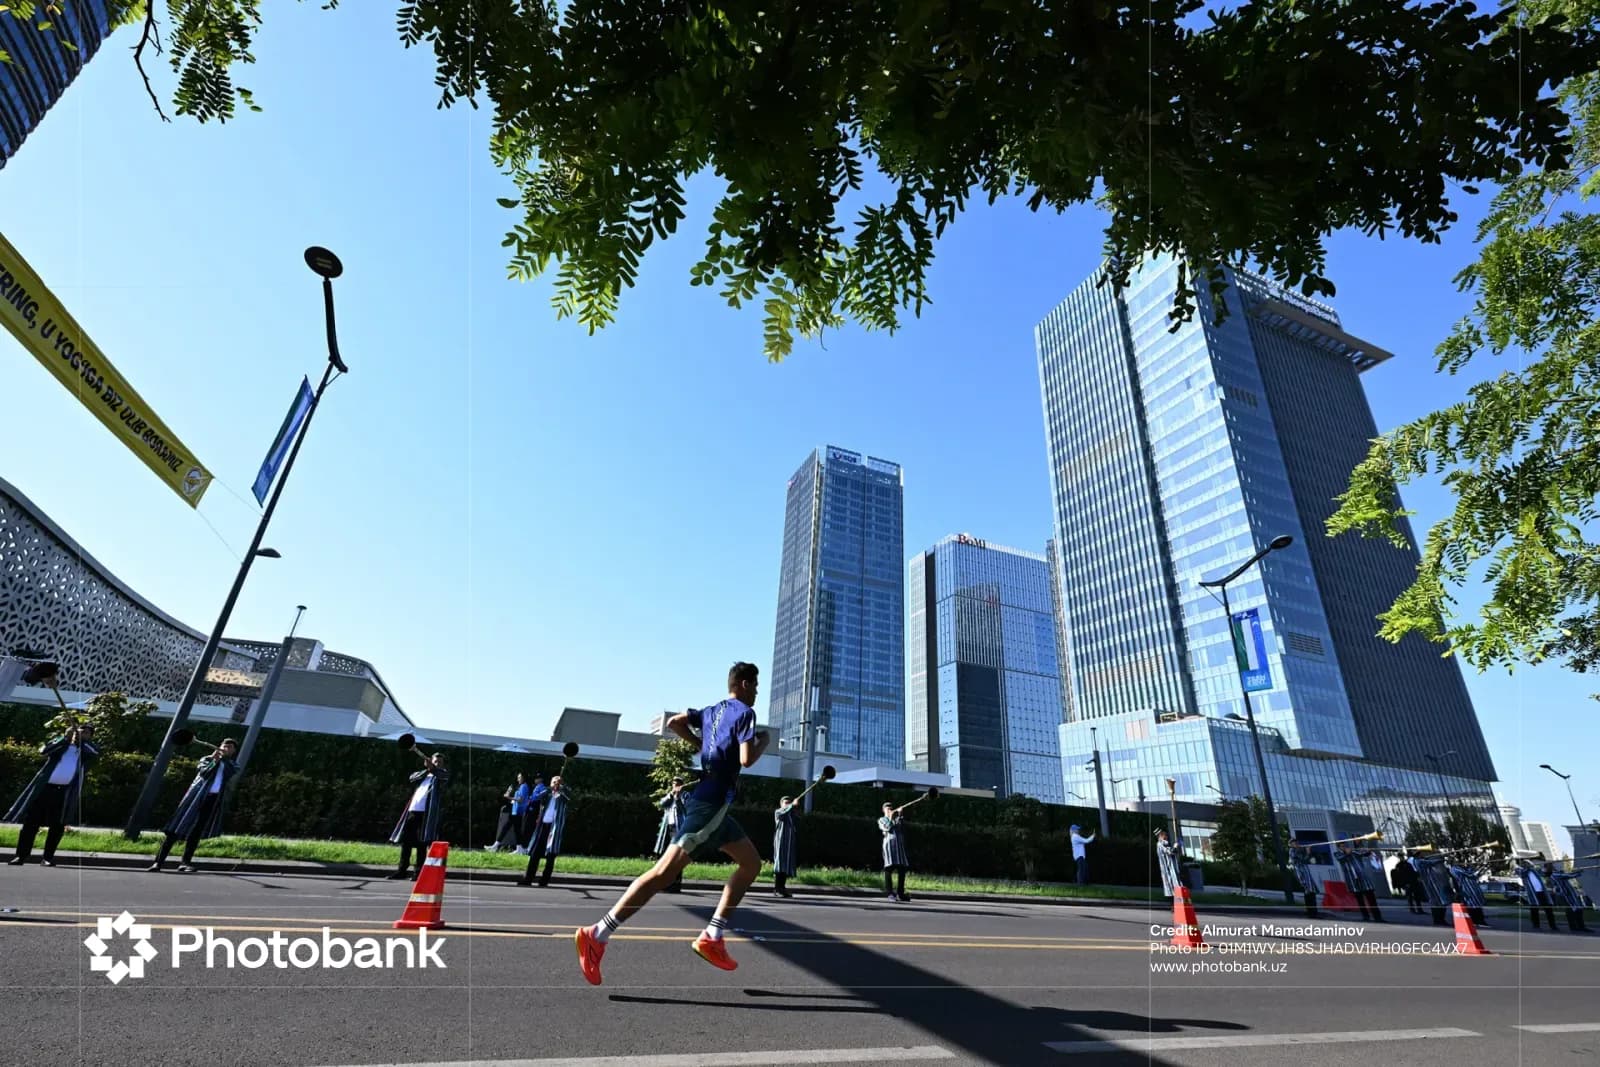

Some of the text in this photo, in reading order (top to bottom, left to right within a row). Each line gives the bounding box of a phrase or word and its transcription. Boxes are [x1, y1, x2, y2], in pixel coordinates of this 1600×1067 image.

[40, 318, 58, 339] U
[101, 385, 123, 412] BIZ
[120, 405, 148, 435] OLIB
[142, 428, 185, 473] BORAMIZ
